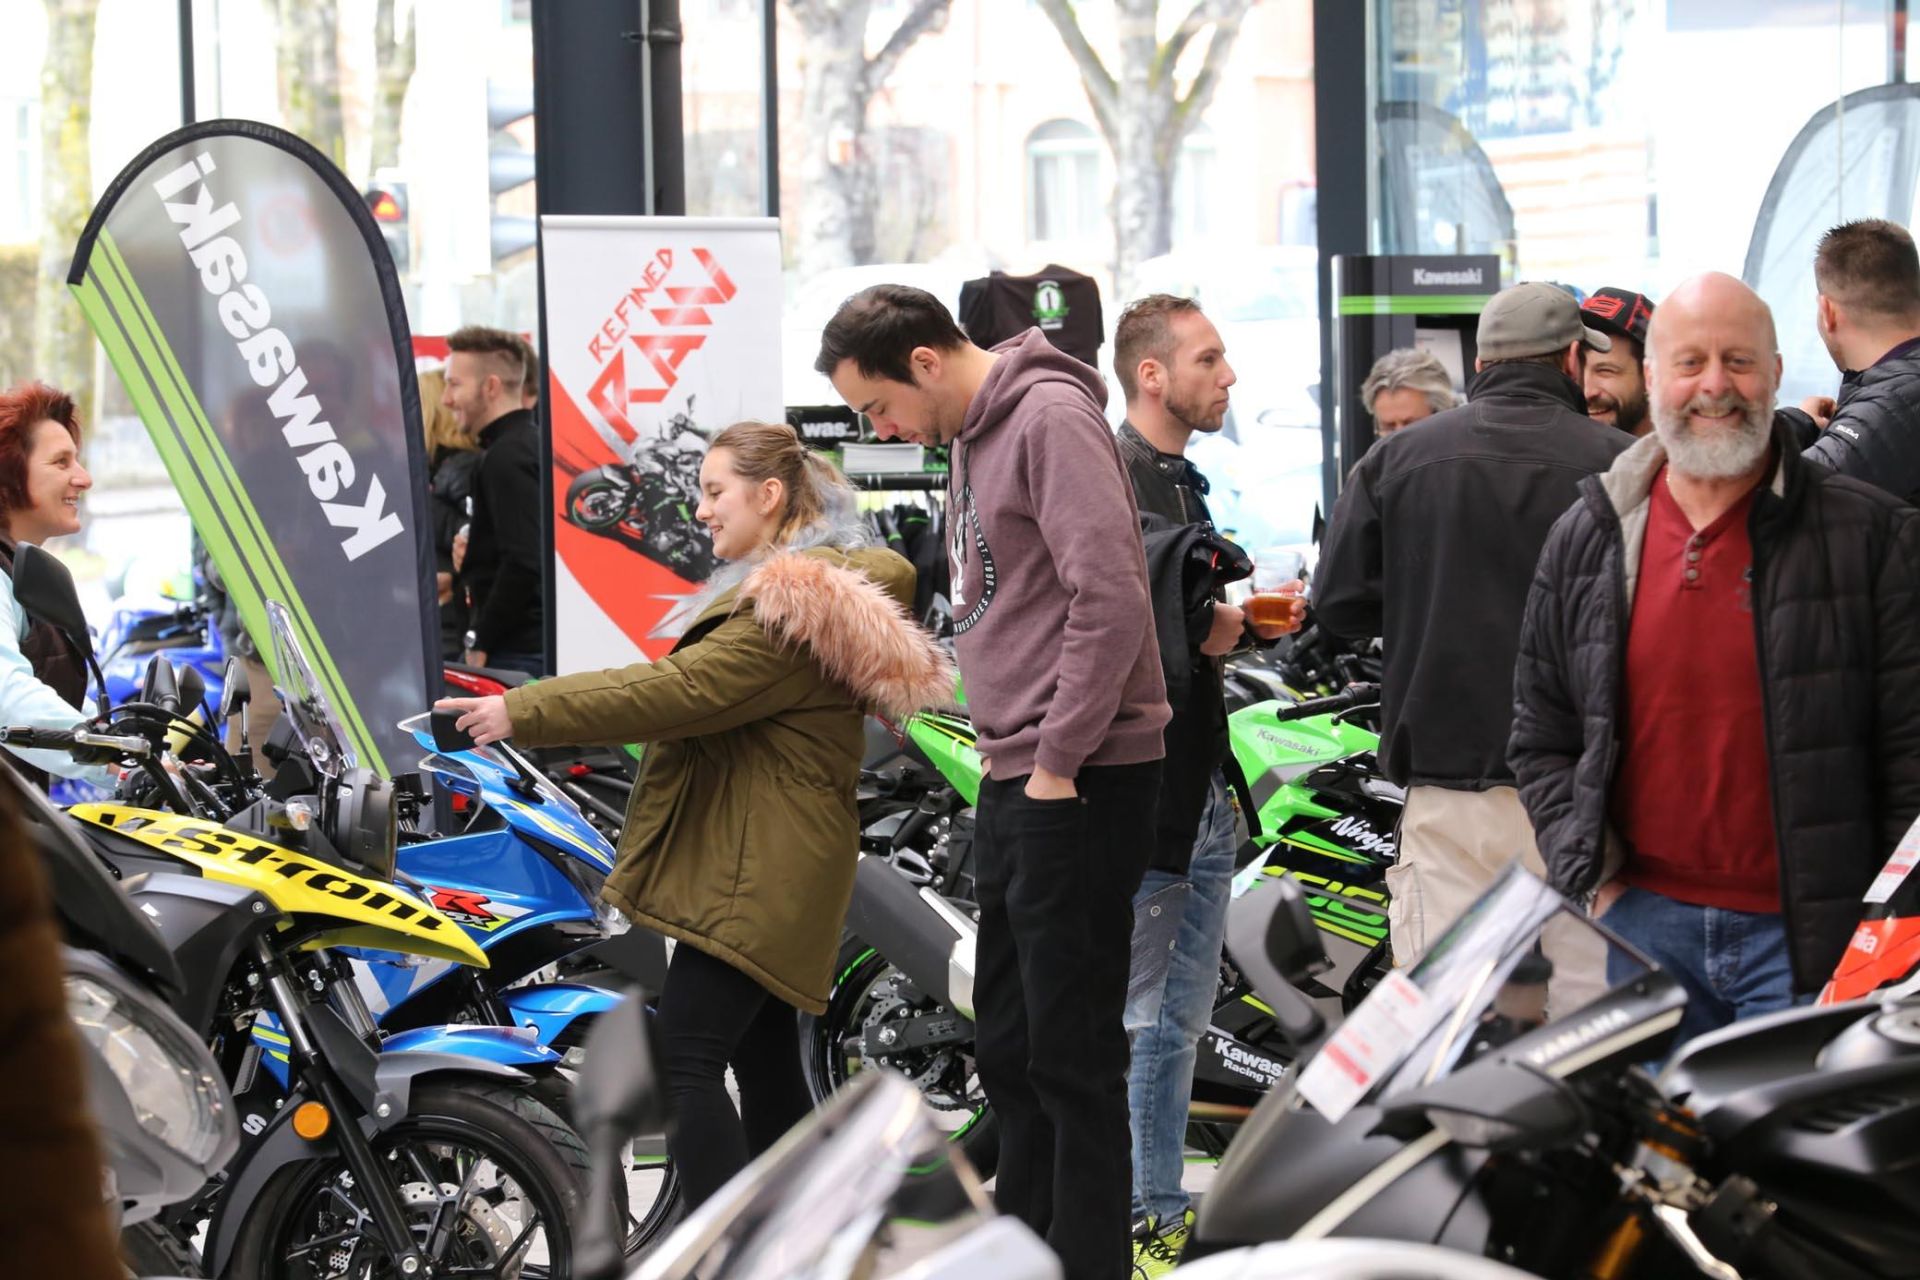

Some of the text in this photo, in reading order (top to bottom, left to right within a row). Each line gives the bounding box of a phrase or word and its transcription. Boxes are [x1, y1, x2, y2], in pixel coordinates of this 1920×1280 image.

[1412, 267, 1483, 286] Kawasaki
[588, 248, 673, 364] REFINED
[1256, 728, 1321, 757] Kawasaki
[1330, 815, 1396, 857] Ninja
[1215, 1037, 1290, 1077] Kawas
[1223, 1058, 1265, 1083] Racing
